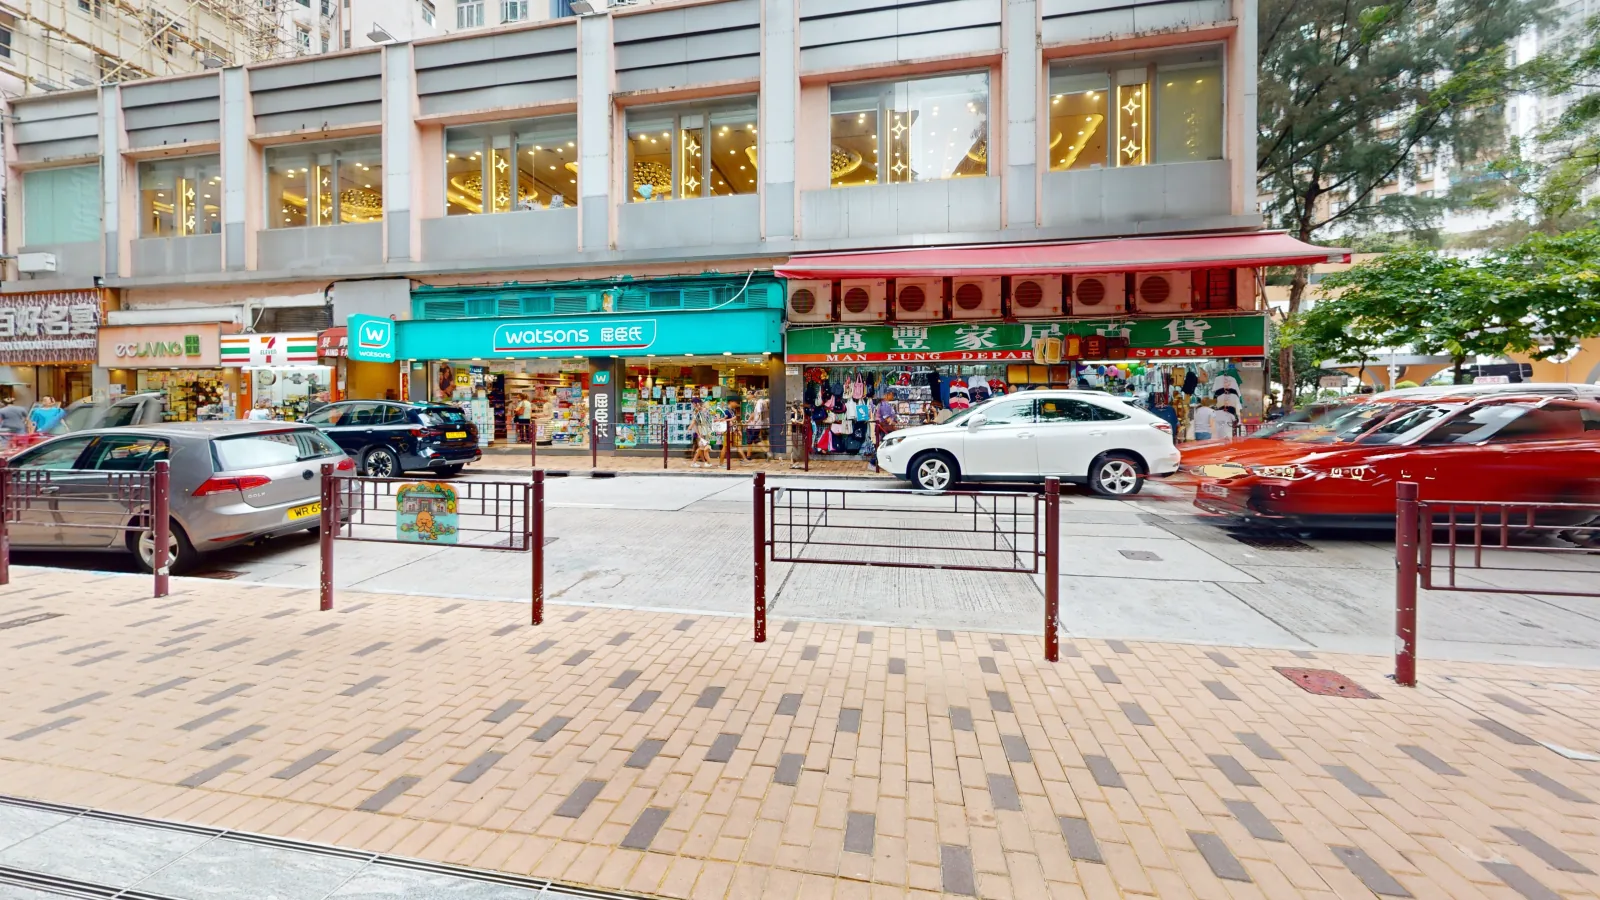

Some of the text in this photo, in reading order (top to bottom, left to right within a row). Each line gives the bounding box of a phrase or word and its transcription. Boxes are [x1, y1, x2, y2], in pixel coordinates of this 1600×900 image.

[505, 326, 643, 344] watsons 屈臣氏
[825, 347, 1214, 362] MAN FUNG DEPAR STORE
[294, 506, 310, 517] WR
